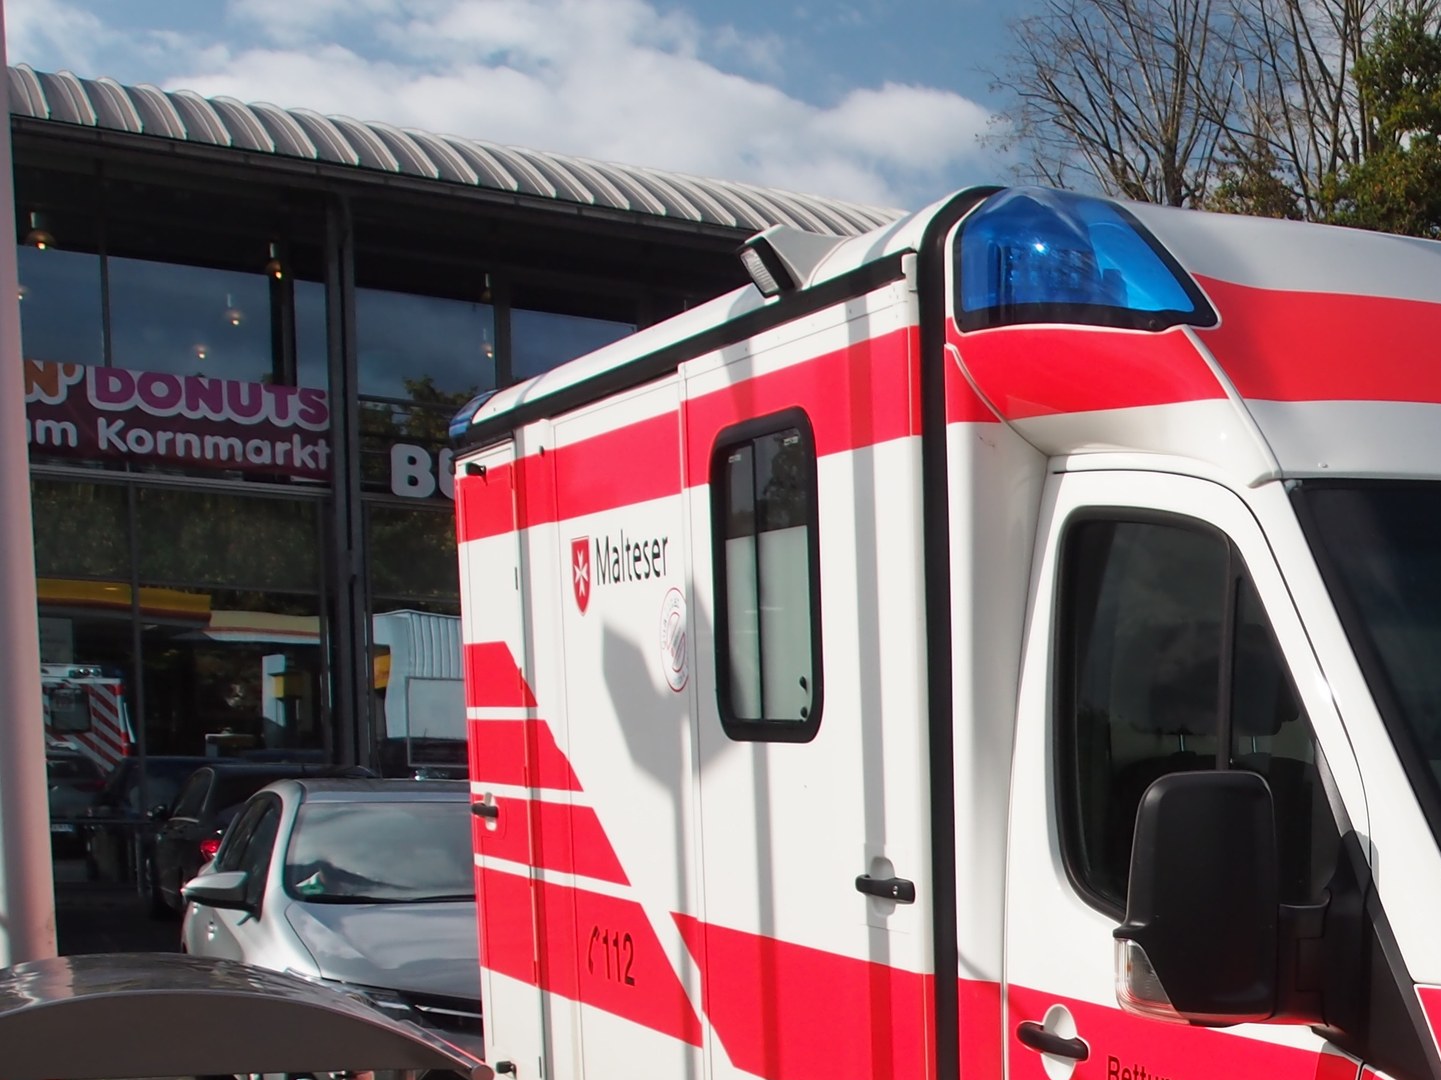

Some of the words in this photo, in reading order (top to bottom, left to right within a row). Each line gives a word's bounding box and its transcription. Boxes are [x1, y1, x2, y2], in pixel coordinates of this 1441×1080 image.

[92, 365, 329, 427] DONUTS
[98, 417, 330, 470] Kornmarkt
[595, 529, 669, 586] Malteser
[602, 929, 635, 986] 112
